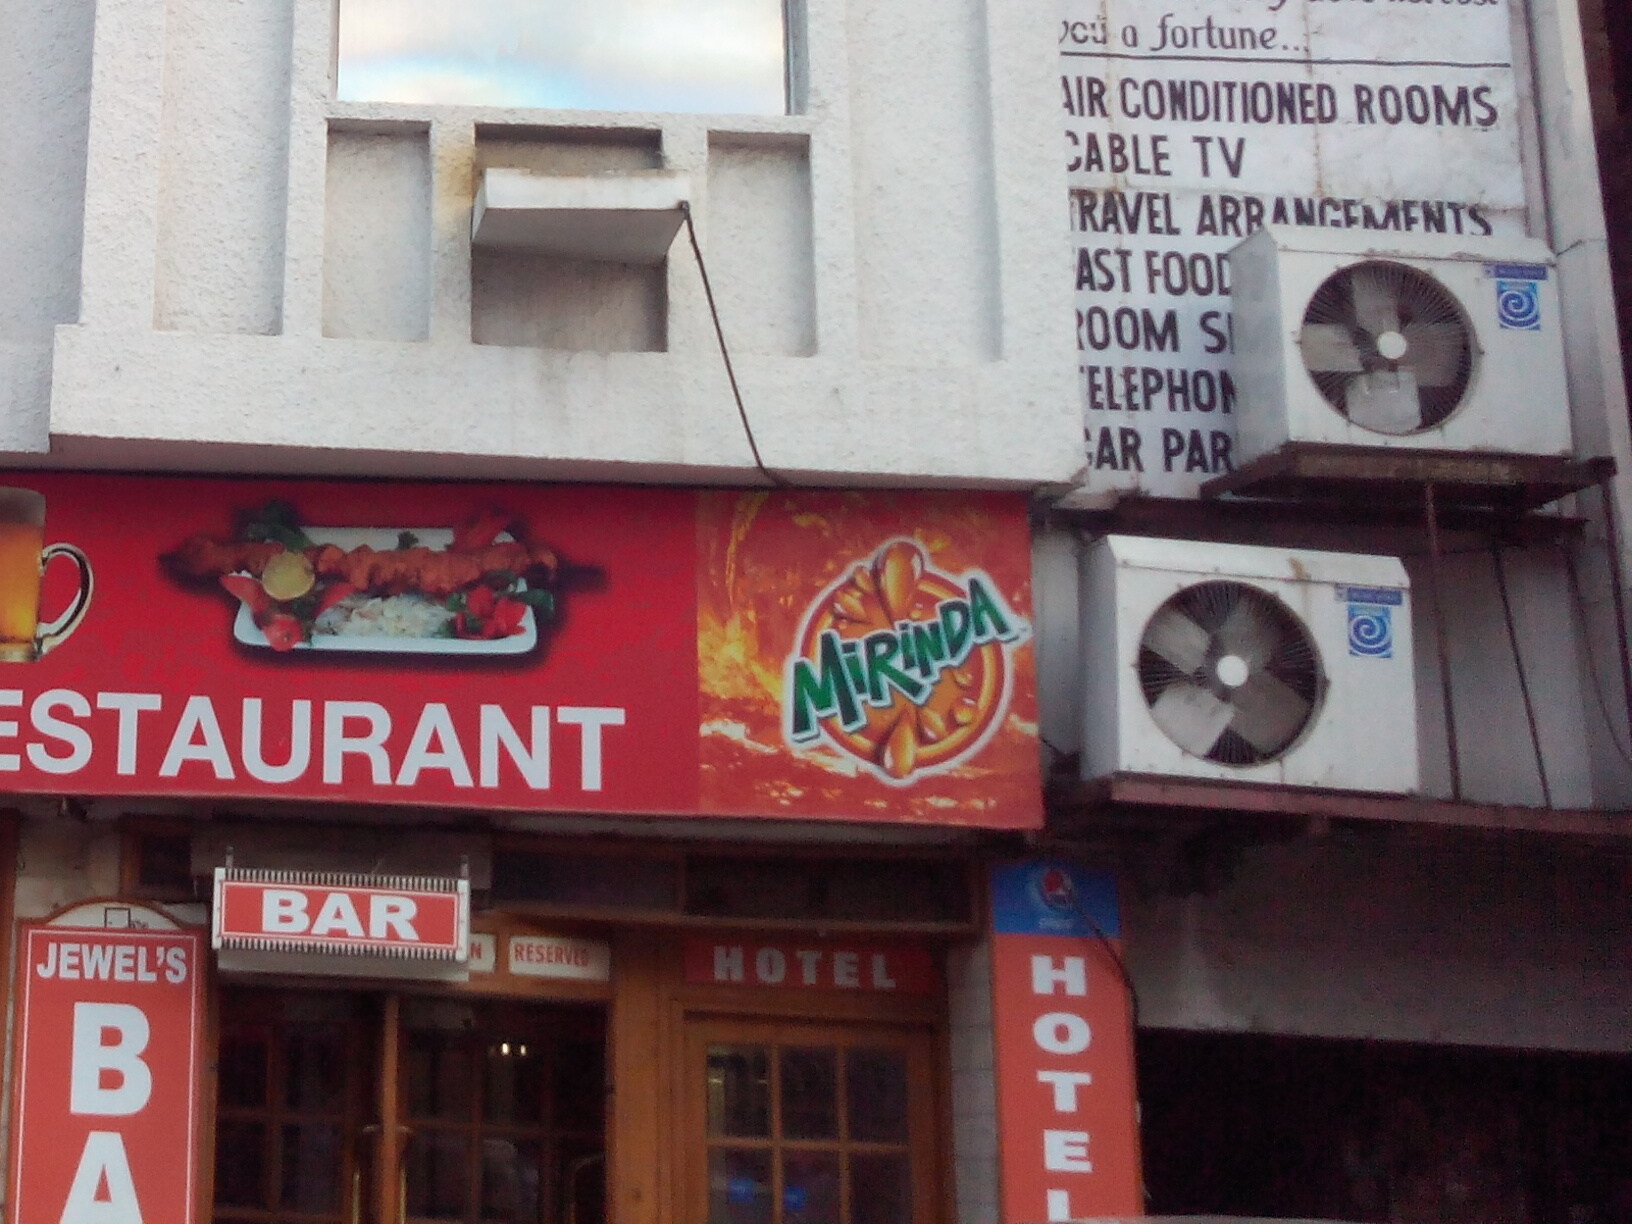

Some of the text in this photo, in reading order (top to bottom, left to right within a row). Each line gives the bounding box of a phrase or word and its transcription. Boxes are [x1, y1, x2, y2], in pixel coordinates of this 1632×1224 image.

[1121, 23, 1139, 48] a
[1119, 77, 1338, 125] CONDITIONED
[1354, 84, 1499, 128] ROOMS
[1065, 130, 1247, 179] CABLE TV
[1074, 247, 1133, 294] AST
[1079, 364, 1239, 415] ELEPHON
[1084, 426, 1145, 473] AR
[261, 888, 420, 942] BAR
[36, 941, 188, 984] JEWEL'S
[713, 944, 897, 990] HOTEL
